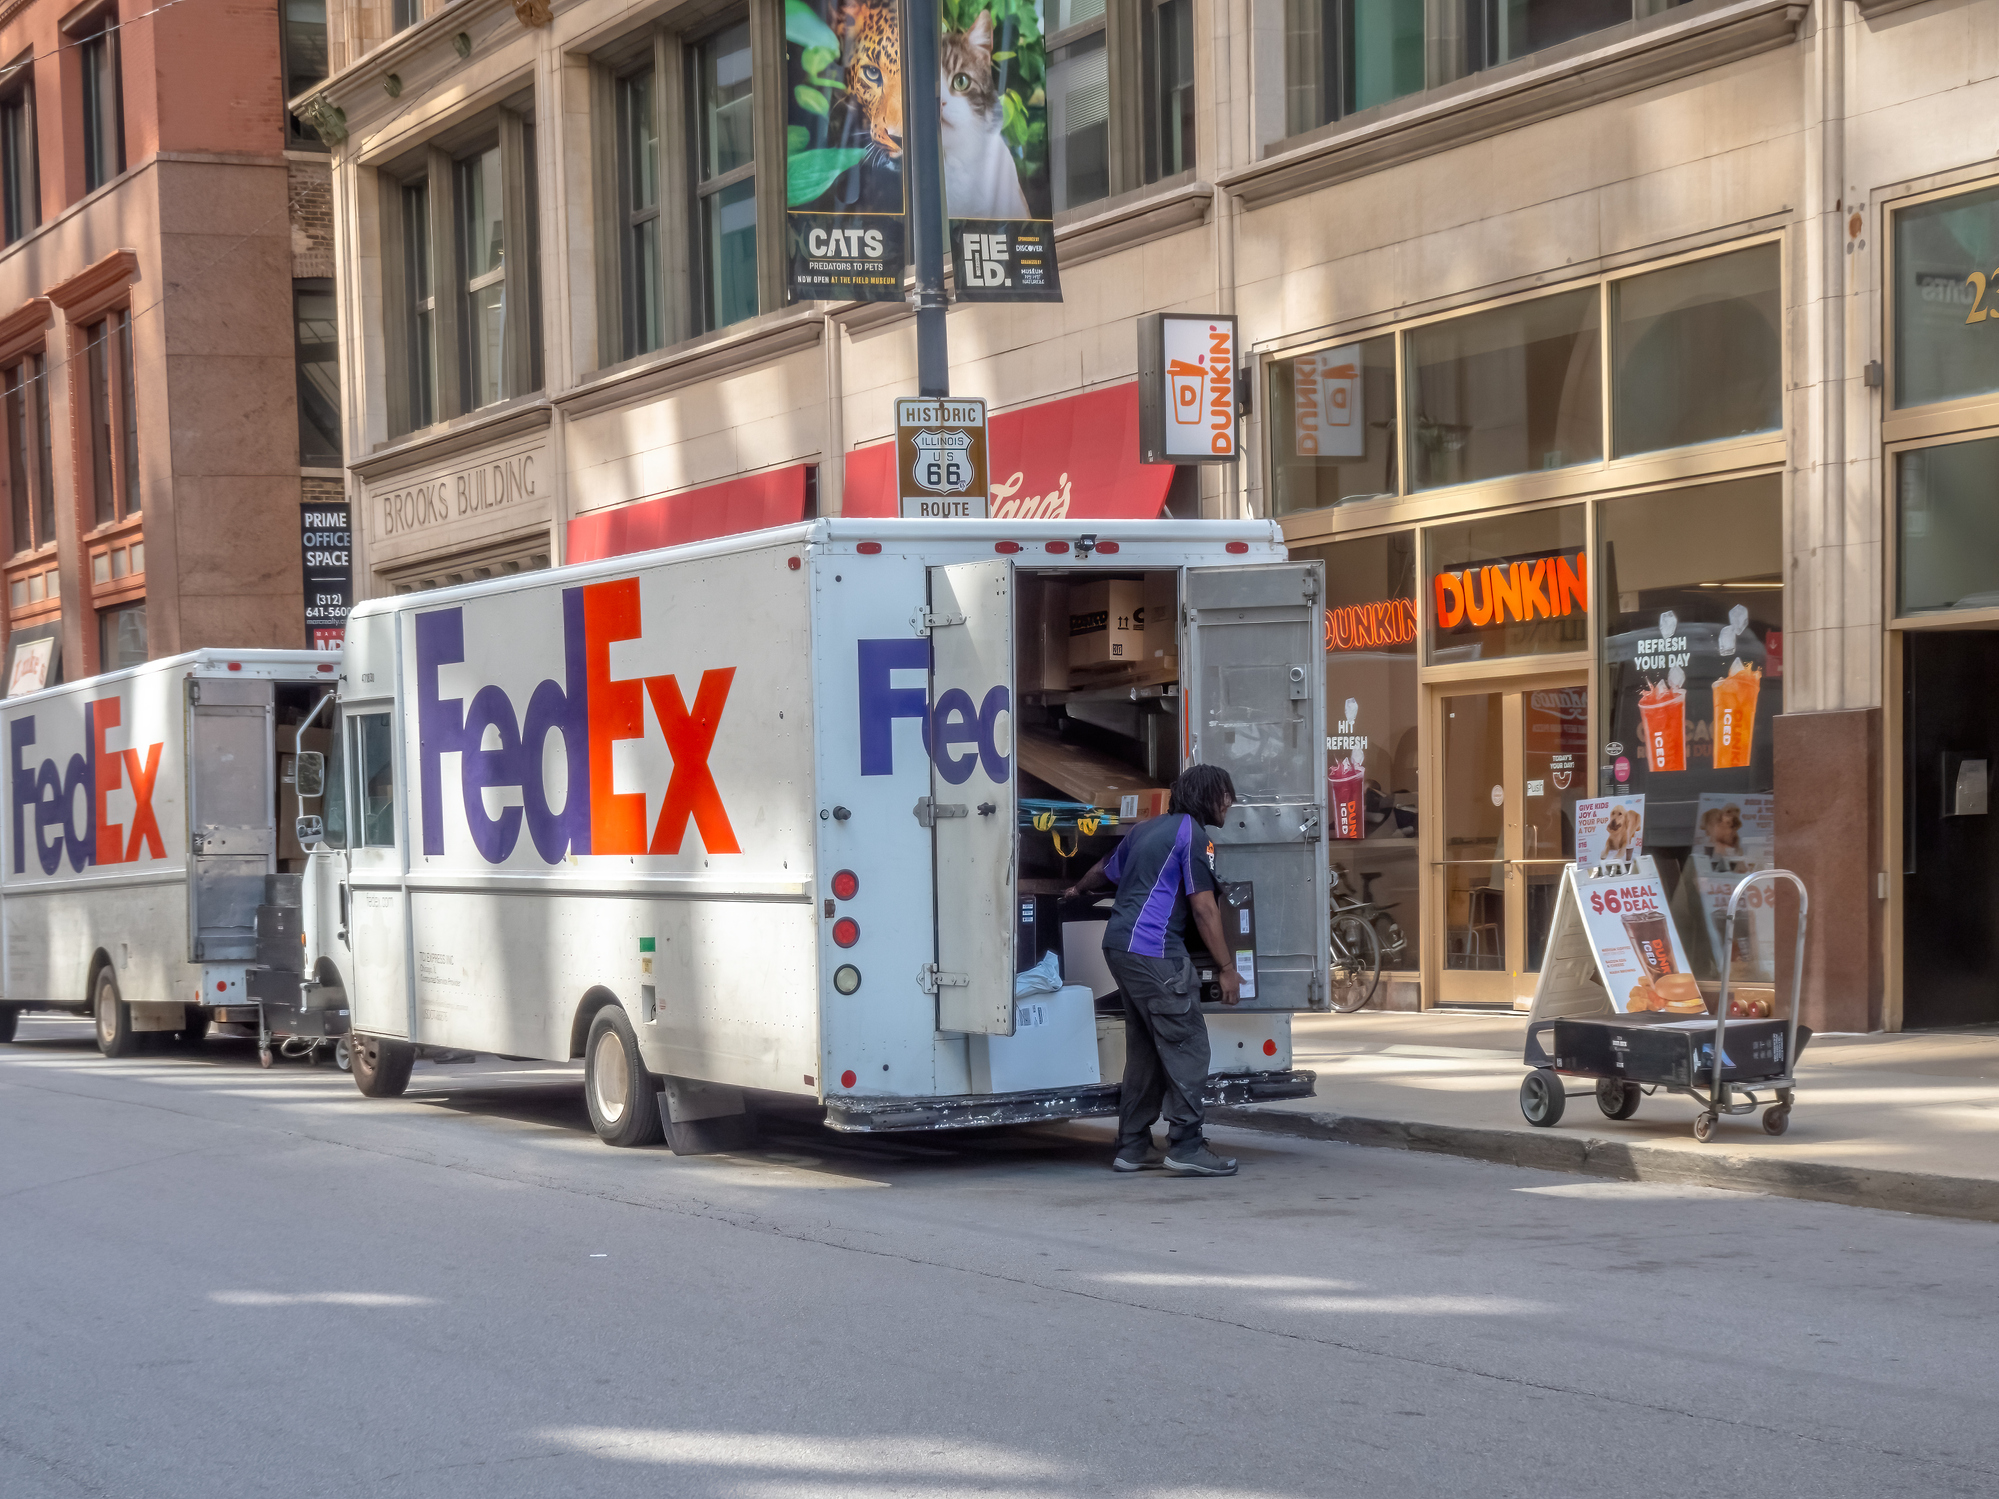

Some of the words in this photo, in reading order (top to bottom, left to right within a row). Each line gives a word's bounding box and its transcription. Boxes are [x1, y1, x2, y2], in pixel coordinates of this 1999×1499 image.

[809, 228, 883, 258] CATS
[963, 233, 1009, 260] FIE
[809, 262, 851, 271] PREDATORS
[853, 263, 863, 271] TO
[864, 263, 883, 271] PETS
[797, 275, 812, 283] NOW
[813, 276, 829, 284] OPEN
[831, 276, 838, 284] AT
[870, 277, 896, 285] MUSEUM
[906, 407, 976, 422] HISTORIC
[921, 437, 964, 446] ILLINOIS
[927, 463, 960, 486] 66
[383, 482, 449, 536] BROOKS
[456, 455, 535, 516] BUILDING
[920, 502, 969, 517] ROUTE
[305, 512, 347, 528] PRIME
[303, 532, 350, 547] OFFICE
[306, 551, 349, 567] SPACE
[1435, 552, 1587, 628] DUNKIN
[317, 593, 342, 605] (312)
[306, 607, 351, 617] 641-5600
[1638, 637, 1687, 654] REFRESH
[1634, 656, 1665, 671] YOUR
[1668, 653, 1690, 669] DAY
[415, 576, 742, 865] FedEx
[1338, 720, 1355, 734] HIT
[1722, 708, 1732, 746] ICED
[1327, 736, 1368, 750] REFRESH
[1654, 731, 1665, 768] ICED
[1552, 754, 1572, 762] TODAY'S
[10, 696, 168, 876] FedEx
[1594, 802, 1609, 810] KIDS
[1340, 802, 1349, 835] ICED
[1578, 819, 1595, 827] YOUR
[1596, 817, 1609, 825] PUP
[1579, 811, 1592, 819] JOY
[1590, 889, 1622, 916] $6
[1620, 885, 1657, 900] MEAL
[1623, 898, 1659, 913] DEAL
[1641, 940, 1657, 966] ICED
